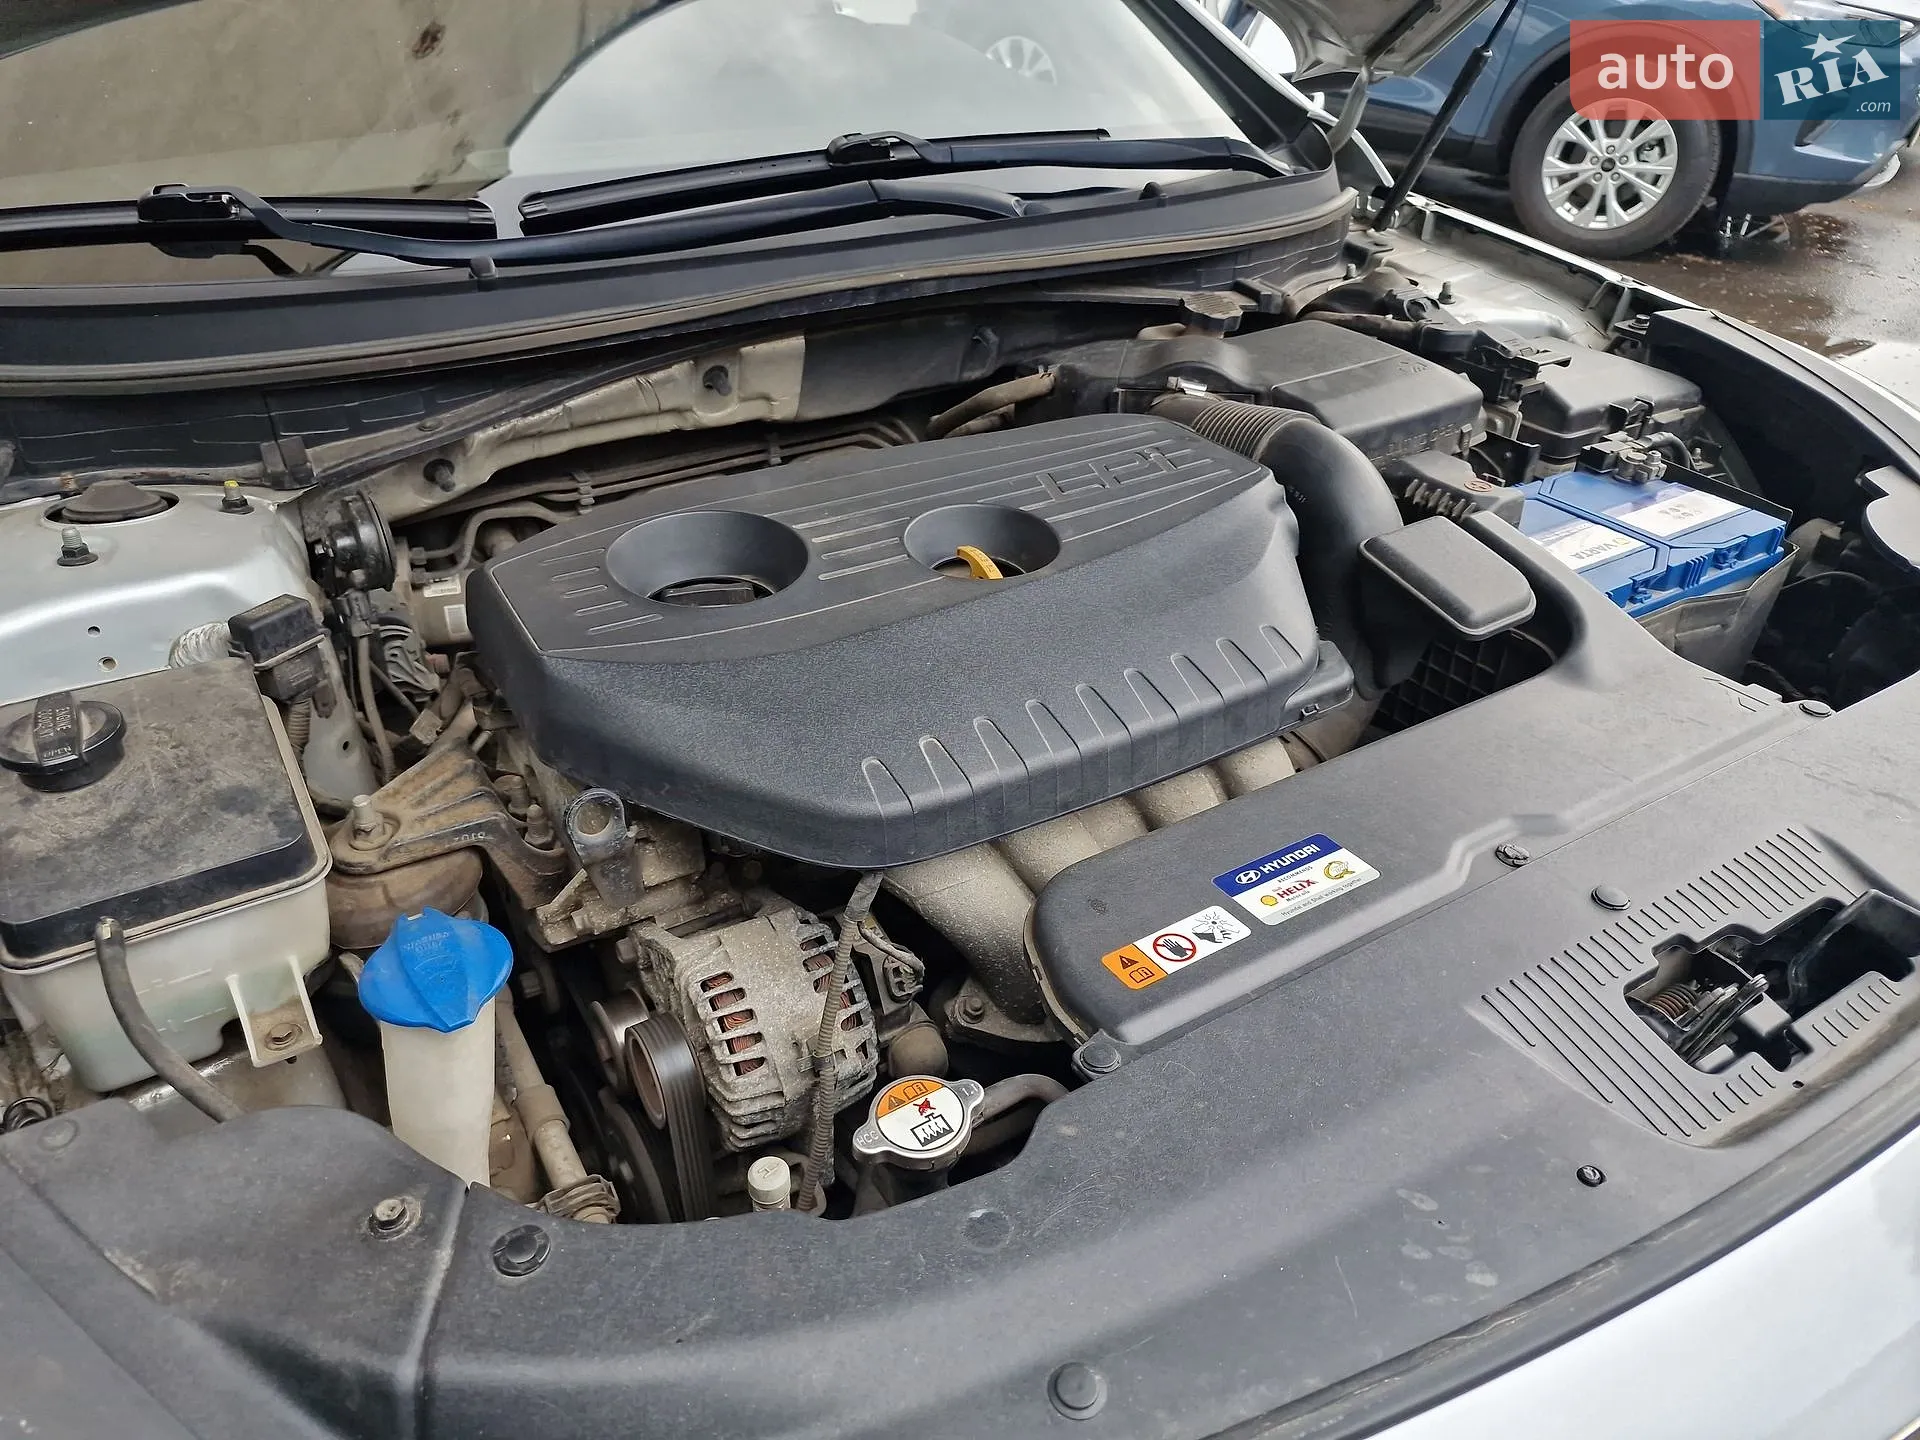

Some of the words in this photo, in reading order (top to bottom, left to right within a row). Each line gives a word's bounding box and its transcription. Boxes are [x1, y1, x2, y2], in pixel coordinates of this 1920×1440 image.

[1569, 542, 1618, 560] VARTA
[1259, 843, 1321, 874] HYUNDAI
[1277, 865, 1313, 883] RECOMMENDS
[1277, 879, 1316, 898] HELIX
[856, 1130, 879, 1146] HCC
